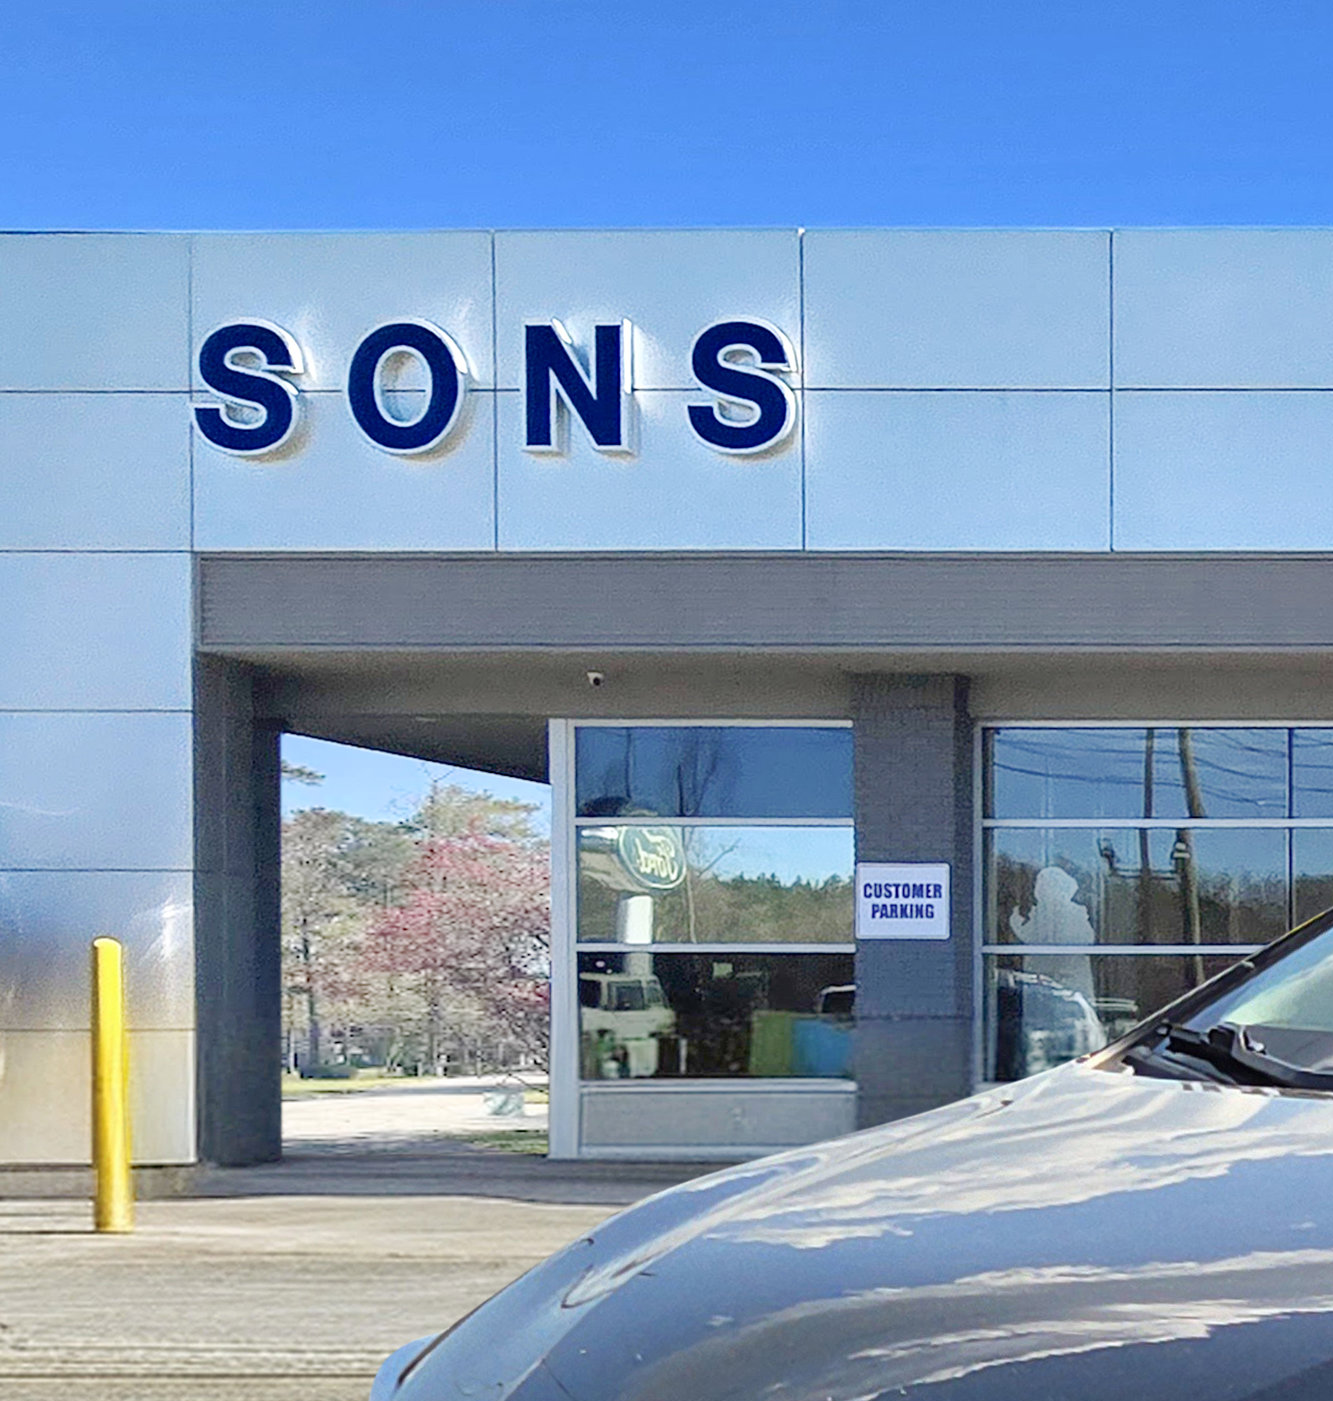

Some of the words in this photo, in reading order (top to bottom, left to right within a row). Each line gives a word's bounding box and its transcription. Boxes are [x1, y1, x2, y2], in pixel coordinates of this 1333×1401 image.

[194, 321, 790, 451] SONS
[863, 883, 943, 899] CUSTOMER
[871, 903, 935, 919] PARKING
